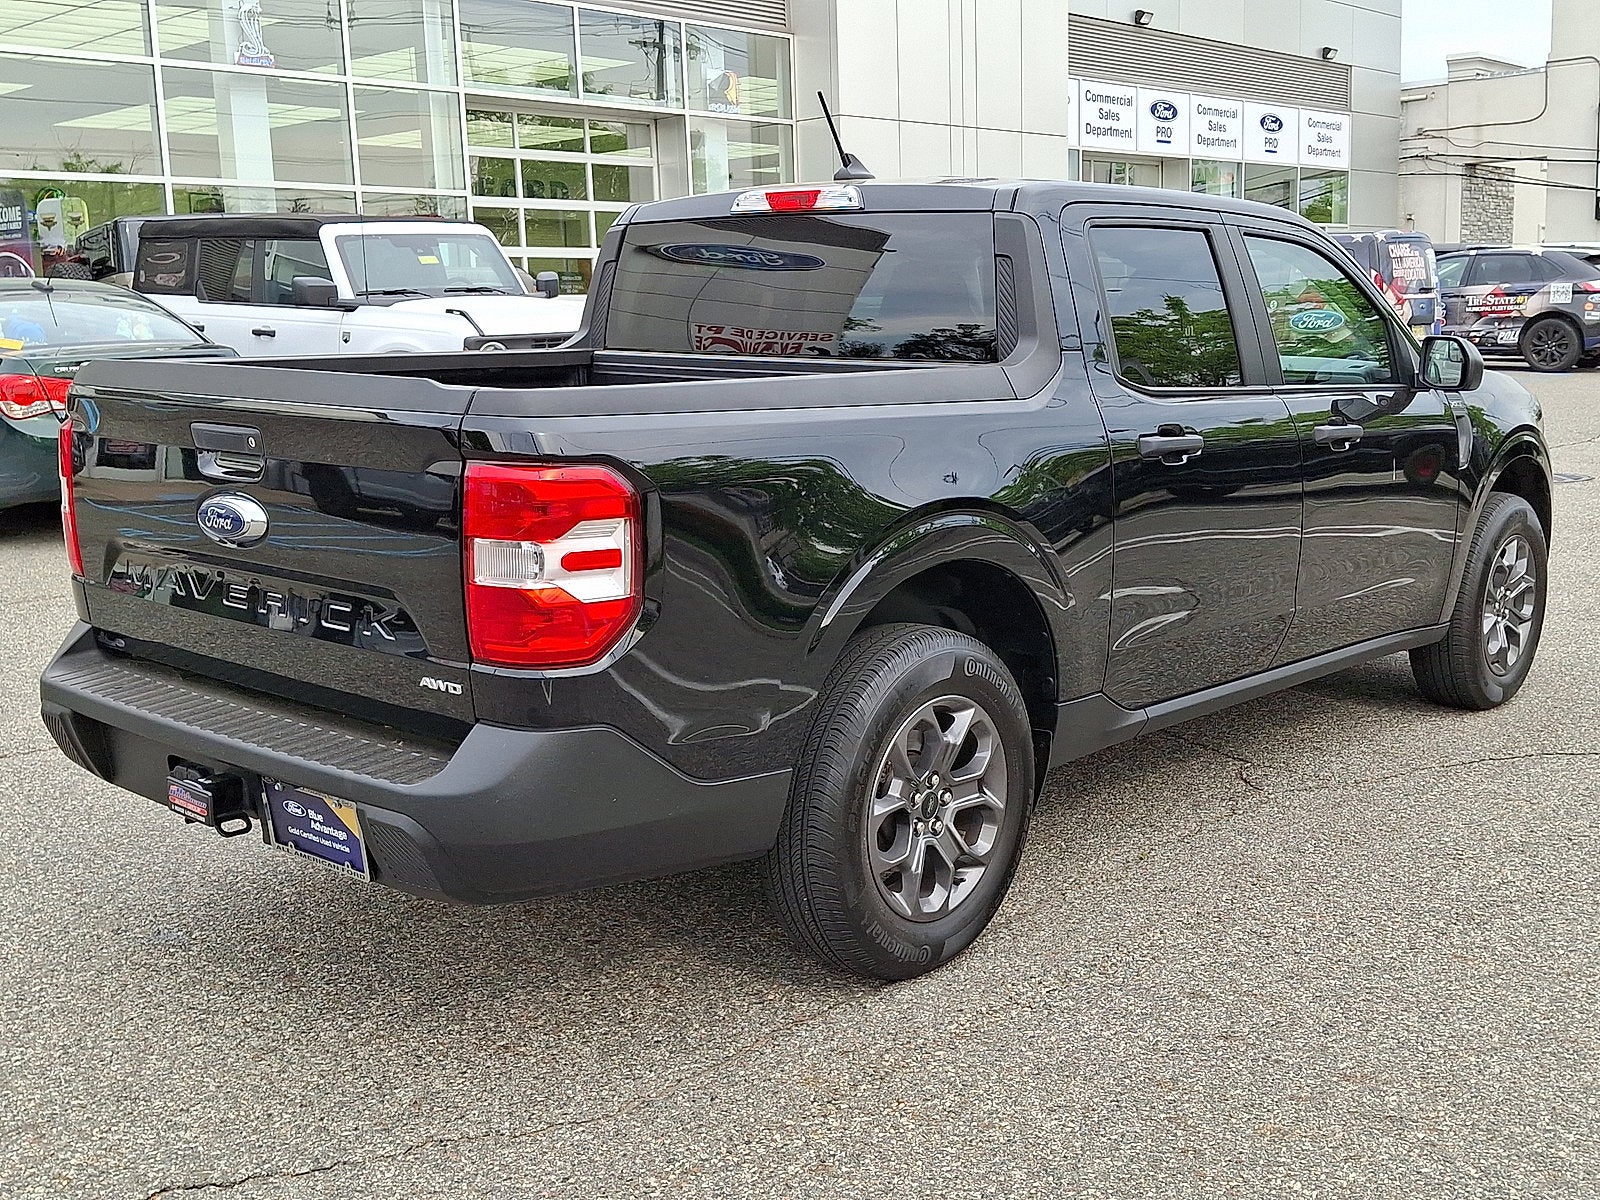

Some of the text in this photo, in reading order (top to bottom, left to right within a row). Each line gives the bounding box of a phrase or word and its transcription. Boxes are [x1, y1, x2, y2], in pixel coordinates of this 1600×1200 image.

[1085, 90, 1133, 107] Commercial
[1098, 108, 1120, 122] Sales
[1153, 102, 1175, 120] Ford
[1196, 104, 1238, 119] Commercial
[1085, 123, 1133, 139] Department
[1208, 120, 1227, 133] Sales
[1307, 117, 1341, 131] Commercial
[1156, 127, 1172, 138] PRO
[1317, 132, 1333, 144] Sales
[1197, 134, 1237, 148] Department
[1264, 138, 1279, 149] PRO
[1307, 146, 1341, 159] Department
[1298, 313, 1334, 328] Ford
[1498, 330, 1519, 341] POLI
[124, 558, 398, 641] MAVERICK
[419, 676, 464, 696] AWD
[963, 655, 1019, 708] Continental
[307, 808, 324, 822] Blue
[311, 820, 348, 841] Advantage
[288, 826, 350, 853] Gold Certified Used Vehicle
[276, 844, 366, 881] ALL AMERICAN FORD
[866, 920, 932, 966] Continental
